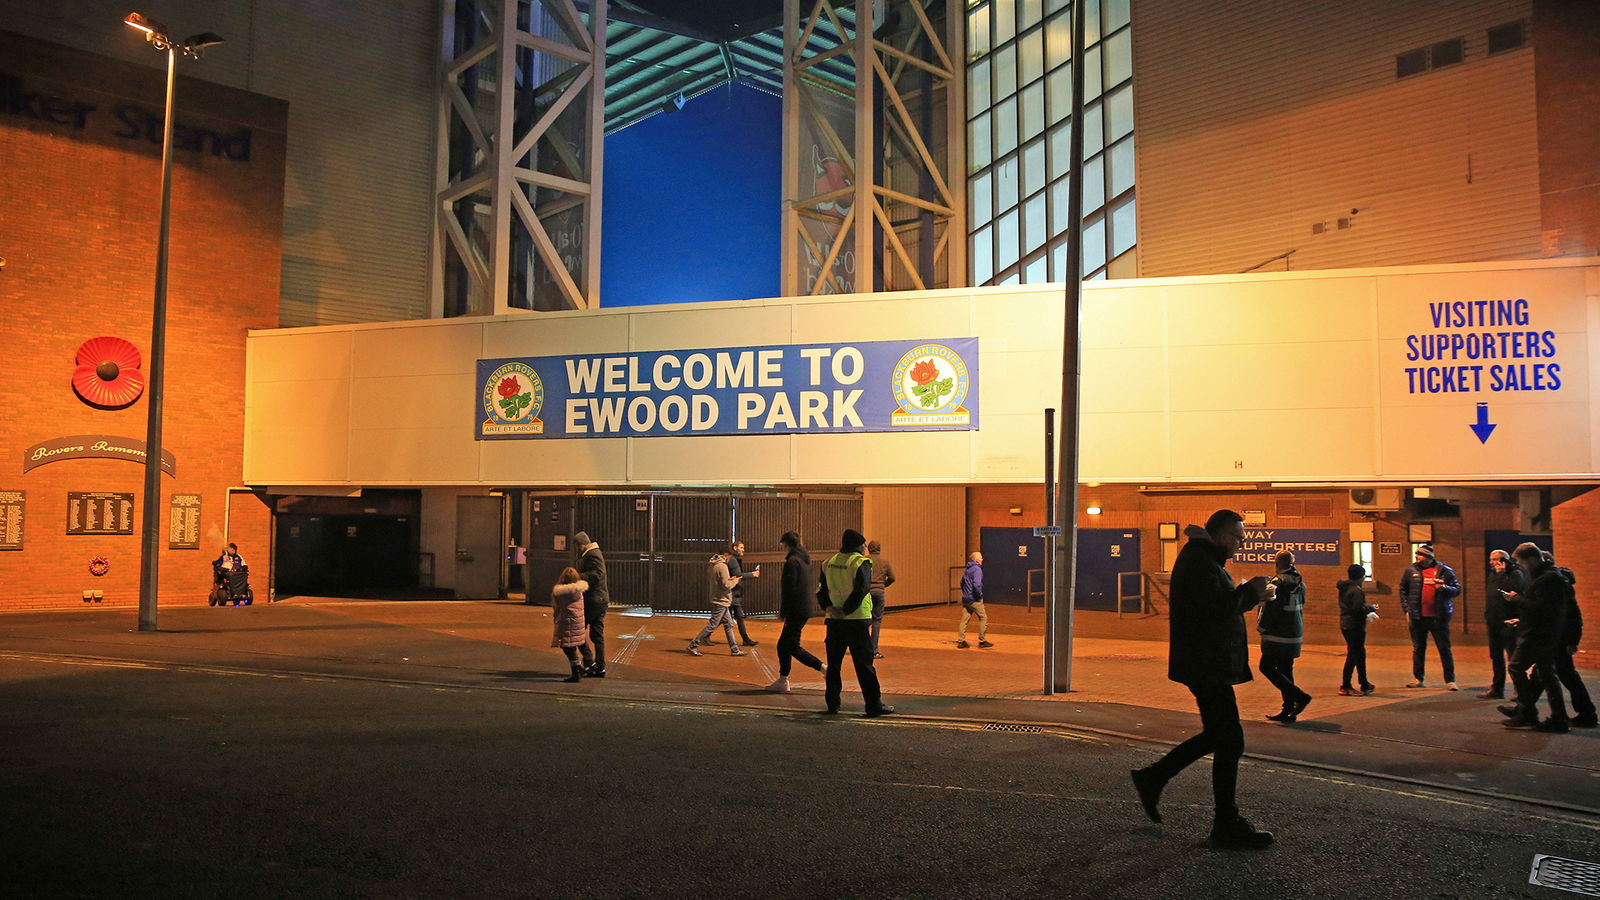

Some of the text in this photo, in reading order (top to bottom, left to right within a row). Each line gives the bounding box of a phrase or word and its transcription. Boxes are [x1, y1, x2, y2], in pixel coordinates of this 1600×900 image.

[1429, 299, 1529, 328] VISITING
[1406, 330, 1556, 361] SUPPORTERS
[565, 346, 865, 394] WELCOME TO
[894, 346, 929, 400] BLACKBURN
[931, 346, 966, 376] ROVERS
[1405, 363, 1562, 394] TICKET SALES
[485, 365, 513, 412] BLACKBURN
[515, 365, 542, 391] ROVERS
[565, 389, 865, 433] EWOOD PARK
[31, 447, 84, 461] Rovers
[1239, 540, 1339, 552] UPPORTERS'
[1244, 531, 1274, 539] WAY
[1234, 553, 1295, 562] TICKE
